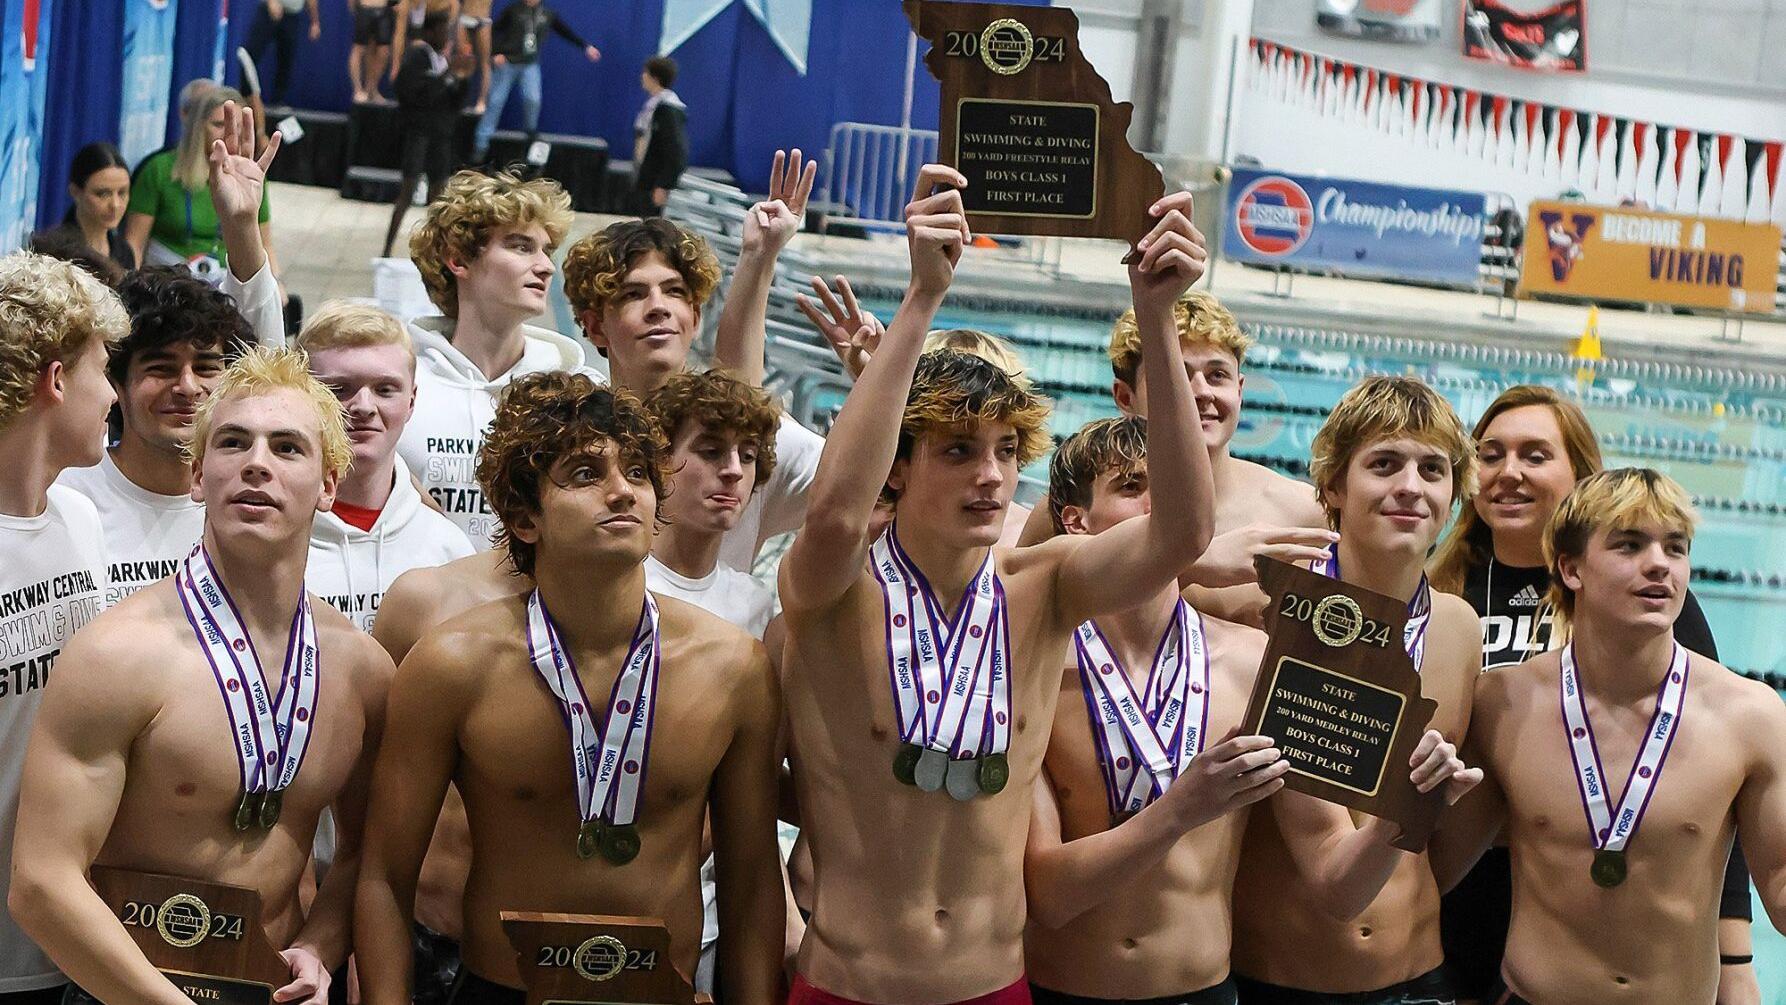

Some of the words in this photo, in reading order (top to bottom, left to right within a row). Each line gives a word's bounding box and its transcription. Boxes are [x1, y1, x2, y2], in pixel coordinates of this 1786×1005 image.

[946, 32, 977, 57] 20
[1035, 37, 1065, 62] 24
[1009, 115, 1047, 127] STATE
[964, 133, 1032, 147] SWIMMING
[1034, 137, 1044, 147] &
[1047, 137, 1091, 149] DIVING
[978, 152, 1003, 161] YARD
[1005, 154, 1059, 164] FREESTYLE
[1060, 156, 1091, 166] RELAY
[985, 170, 1017, 182] BOYS
[1021, 172, 1059, 183] CLASS
[987, 190, 1021, 202] FIRST
[1025, 192, 1064, 204] PLACE
[1319, 186, 1482, 247] Championships
[1602, 213, 1681, 247] BECOME
[1690, 221, 1705, 249] A
[1650, 247, 1743, 288] VIKING
[428, 457, 474, 483] SWI
[53, 570, 98, 599] CENTRAL
[198, 576, 222, 608] MSHSAA
[53, 605, 66, 642] &
[1280, 594, 1313, 621] 20
[1360, 620, 1392, 648] 24
[917, 629, 934, 662] MSHSAA
[898, 656, 911, 689] MSHSAA
[953, 666, 971, 698] MSHSAA
[252, 680, 268, 716] MSHSAA
[1321, 683, 1358, 702] STATE
[1120, 696, 1141, 726] MSHSAA
[1162, 698, 1181, 729] MSHSAA
[1275, 687, 1338, 717] SWIMMING
[1338, 708, 1348, 718] &
[1350, 712, 1391, 733] DIVING
[239, 722, 255, 757] MSHSAA
[1185, 726, 1197, 757] MSHSAA
[1276, 706, 1290, 717] 200
[1290, 711, 1315, 725] YARD
[1315, 717, 1352, 736] MEDLEY
[1352, 730, 1380, 746] RELAY
[1285, 726, 1316, 745] BOYS
[1317, 736, 1353, 755] CLASS
[1654, 712, 1673, 740] MSHSAA
[599, 750, 616, 782] MSHSAA
[1281, 745, 1315, 765] FIRST
[1316, 755, 1353, 775] PLACE
[1584, 765, 1600, 797] MSHSAA
[1615, 807, 1634, 838] MSHSAA
[122, 902, 155, 928] 20
[212, 915, 243, 940] 24
[538, 947, 571, 966] 20
[625, 951, 657, 970] 24
[183, 985, 220, 1000] STATE
